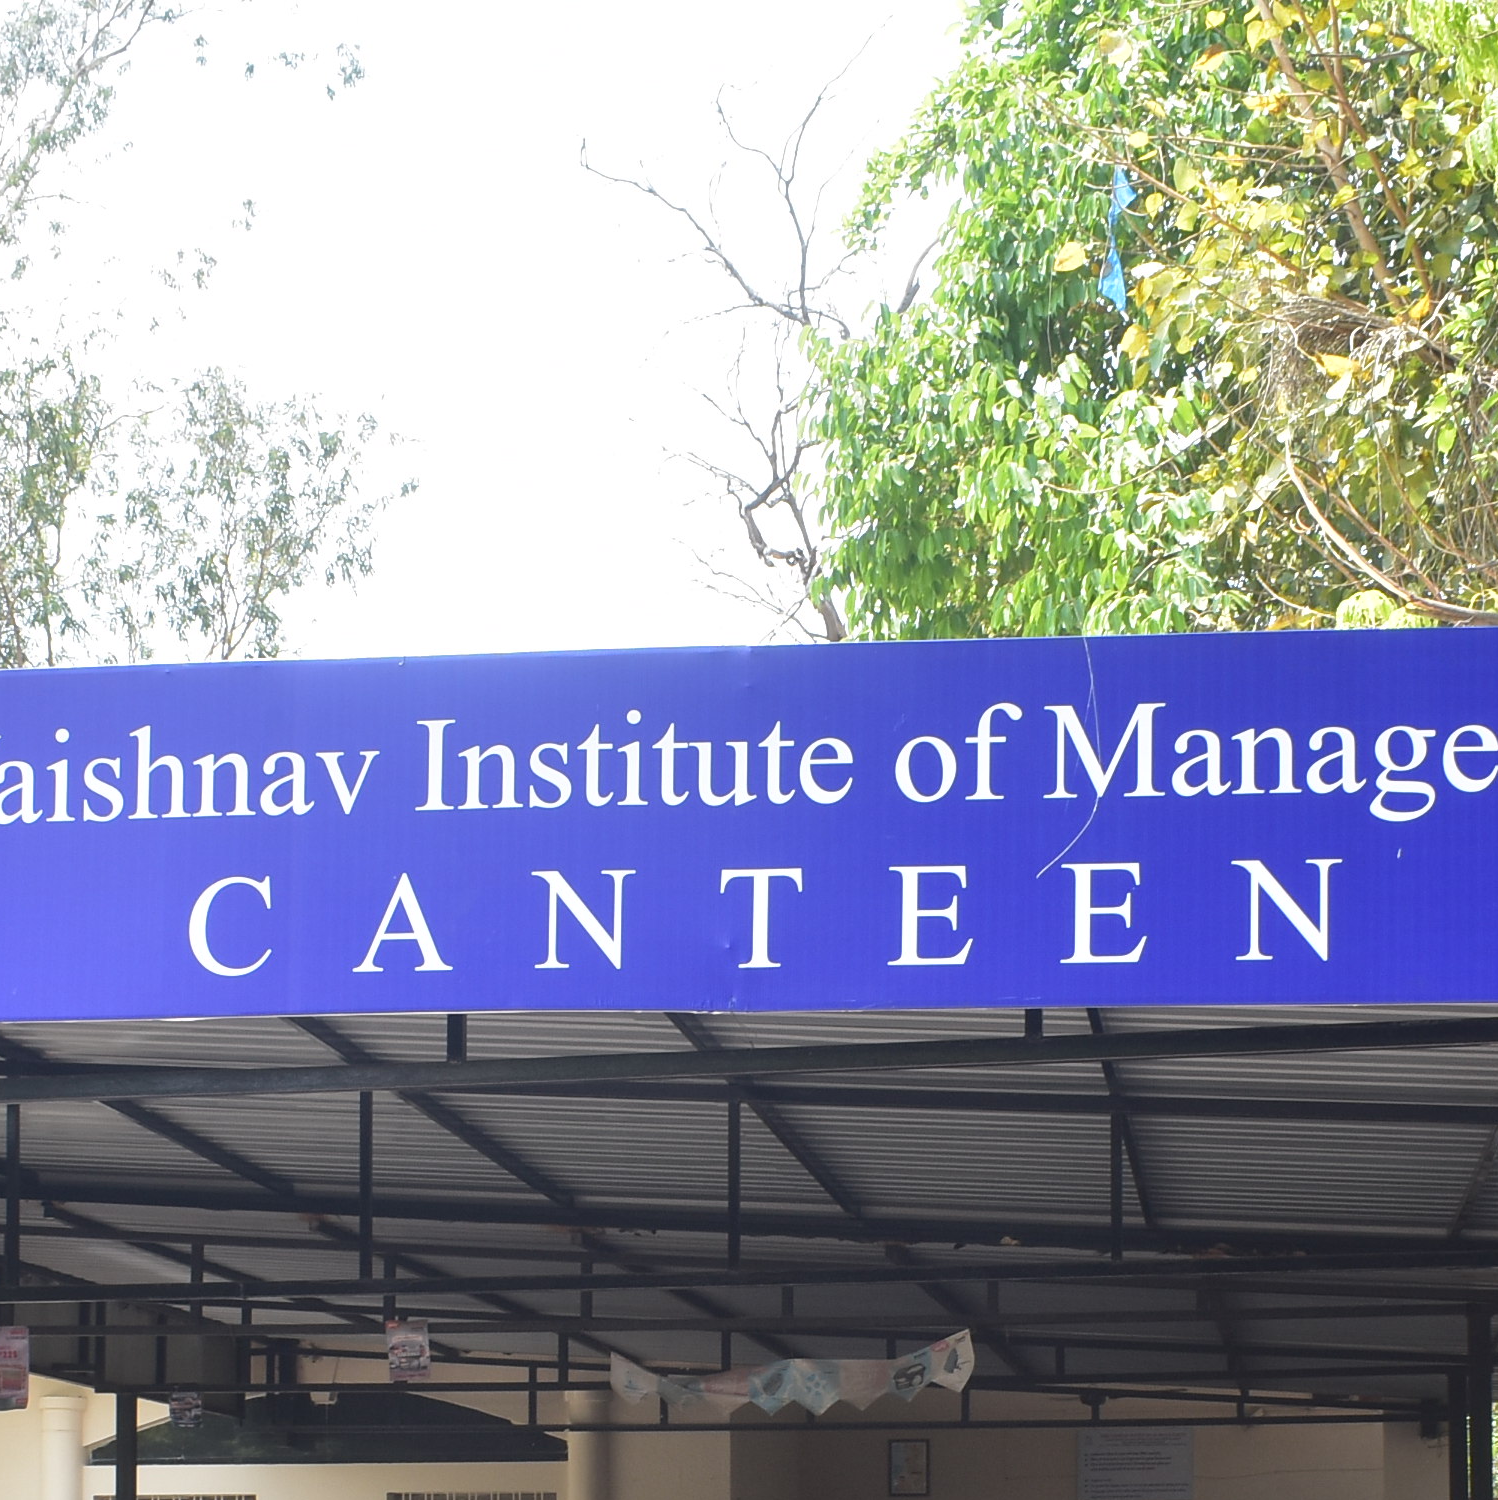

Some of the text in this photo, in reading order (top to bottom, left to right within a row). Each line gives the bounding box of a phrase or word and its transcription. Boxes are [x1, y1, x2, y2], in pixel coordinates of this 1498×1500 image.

[413, 709, 855, 812] Institute
[893, 702, 1024, 803] of
[187, 858, 1344, 978] CANTEEN
